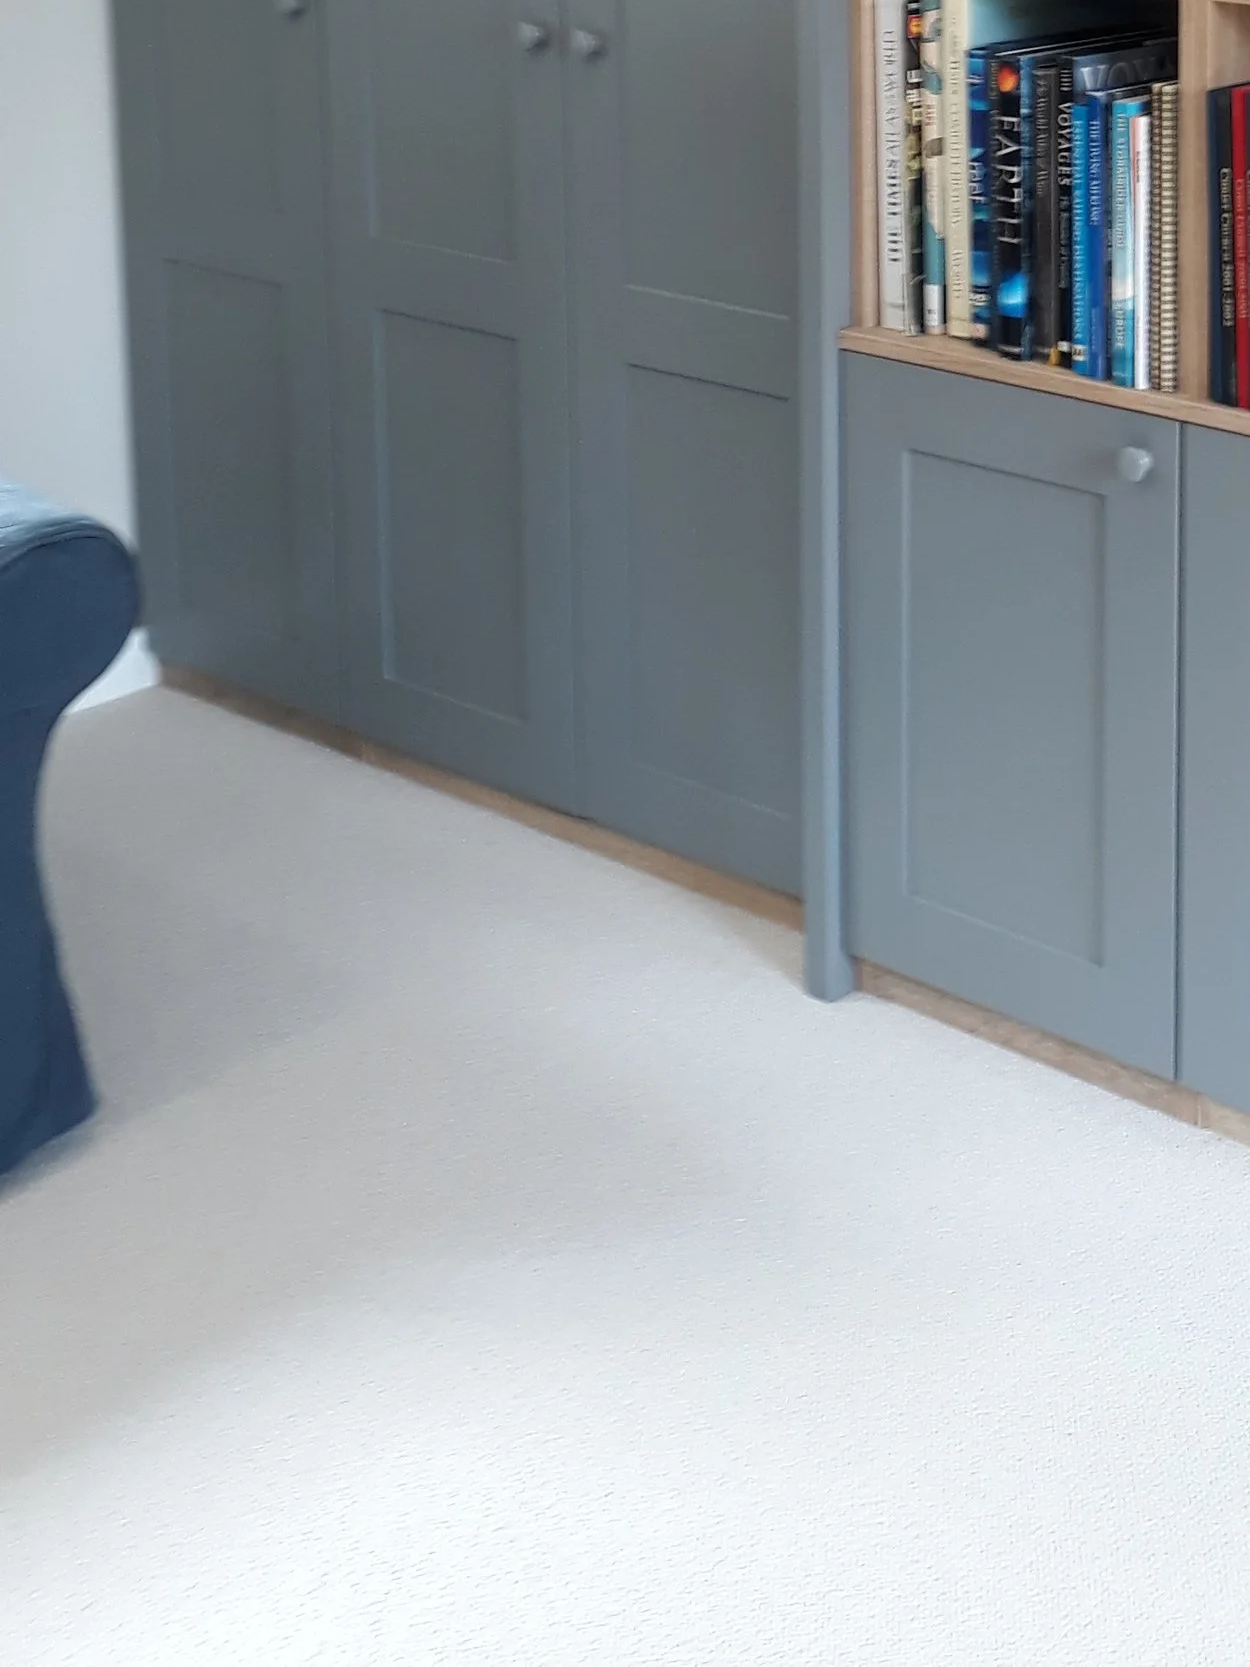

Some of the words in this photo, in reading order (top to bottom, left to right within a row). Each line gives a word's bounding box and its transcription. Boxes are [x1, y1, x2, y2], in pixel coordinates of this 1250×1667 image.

[1056, 102, 1073, 186] VOYAGES
[1114, 112, 1127, 135] THE
[995, 116, 1023, 244] EARTH
